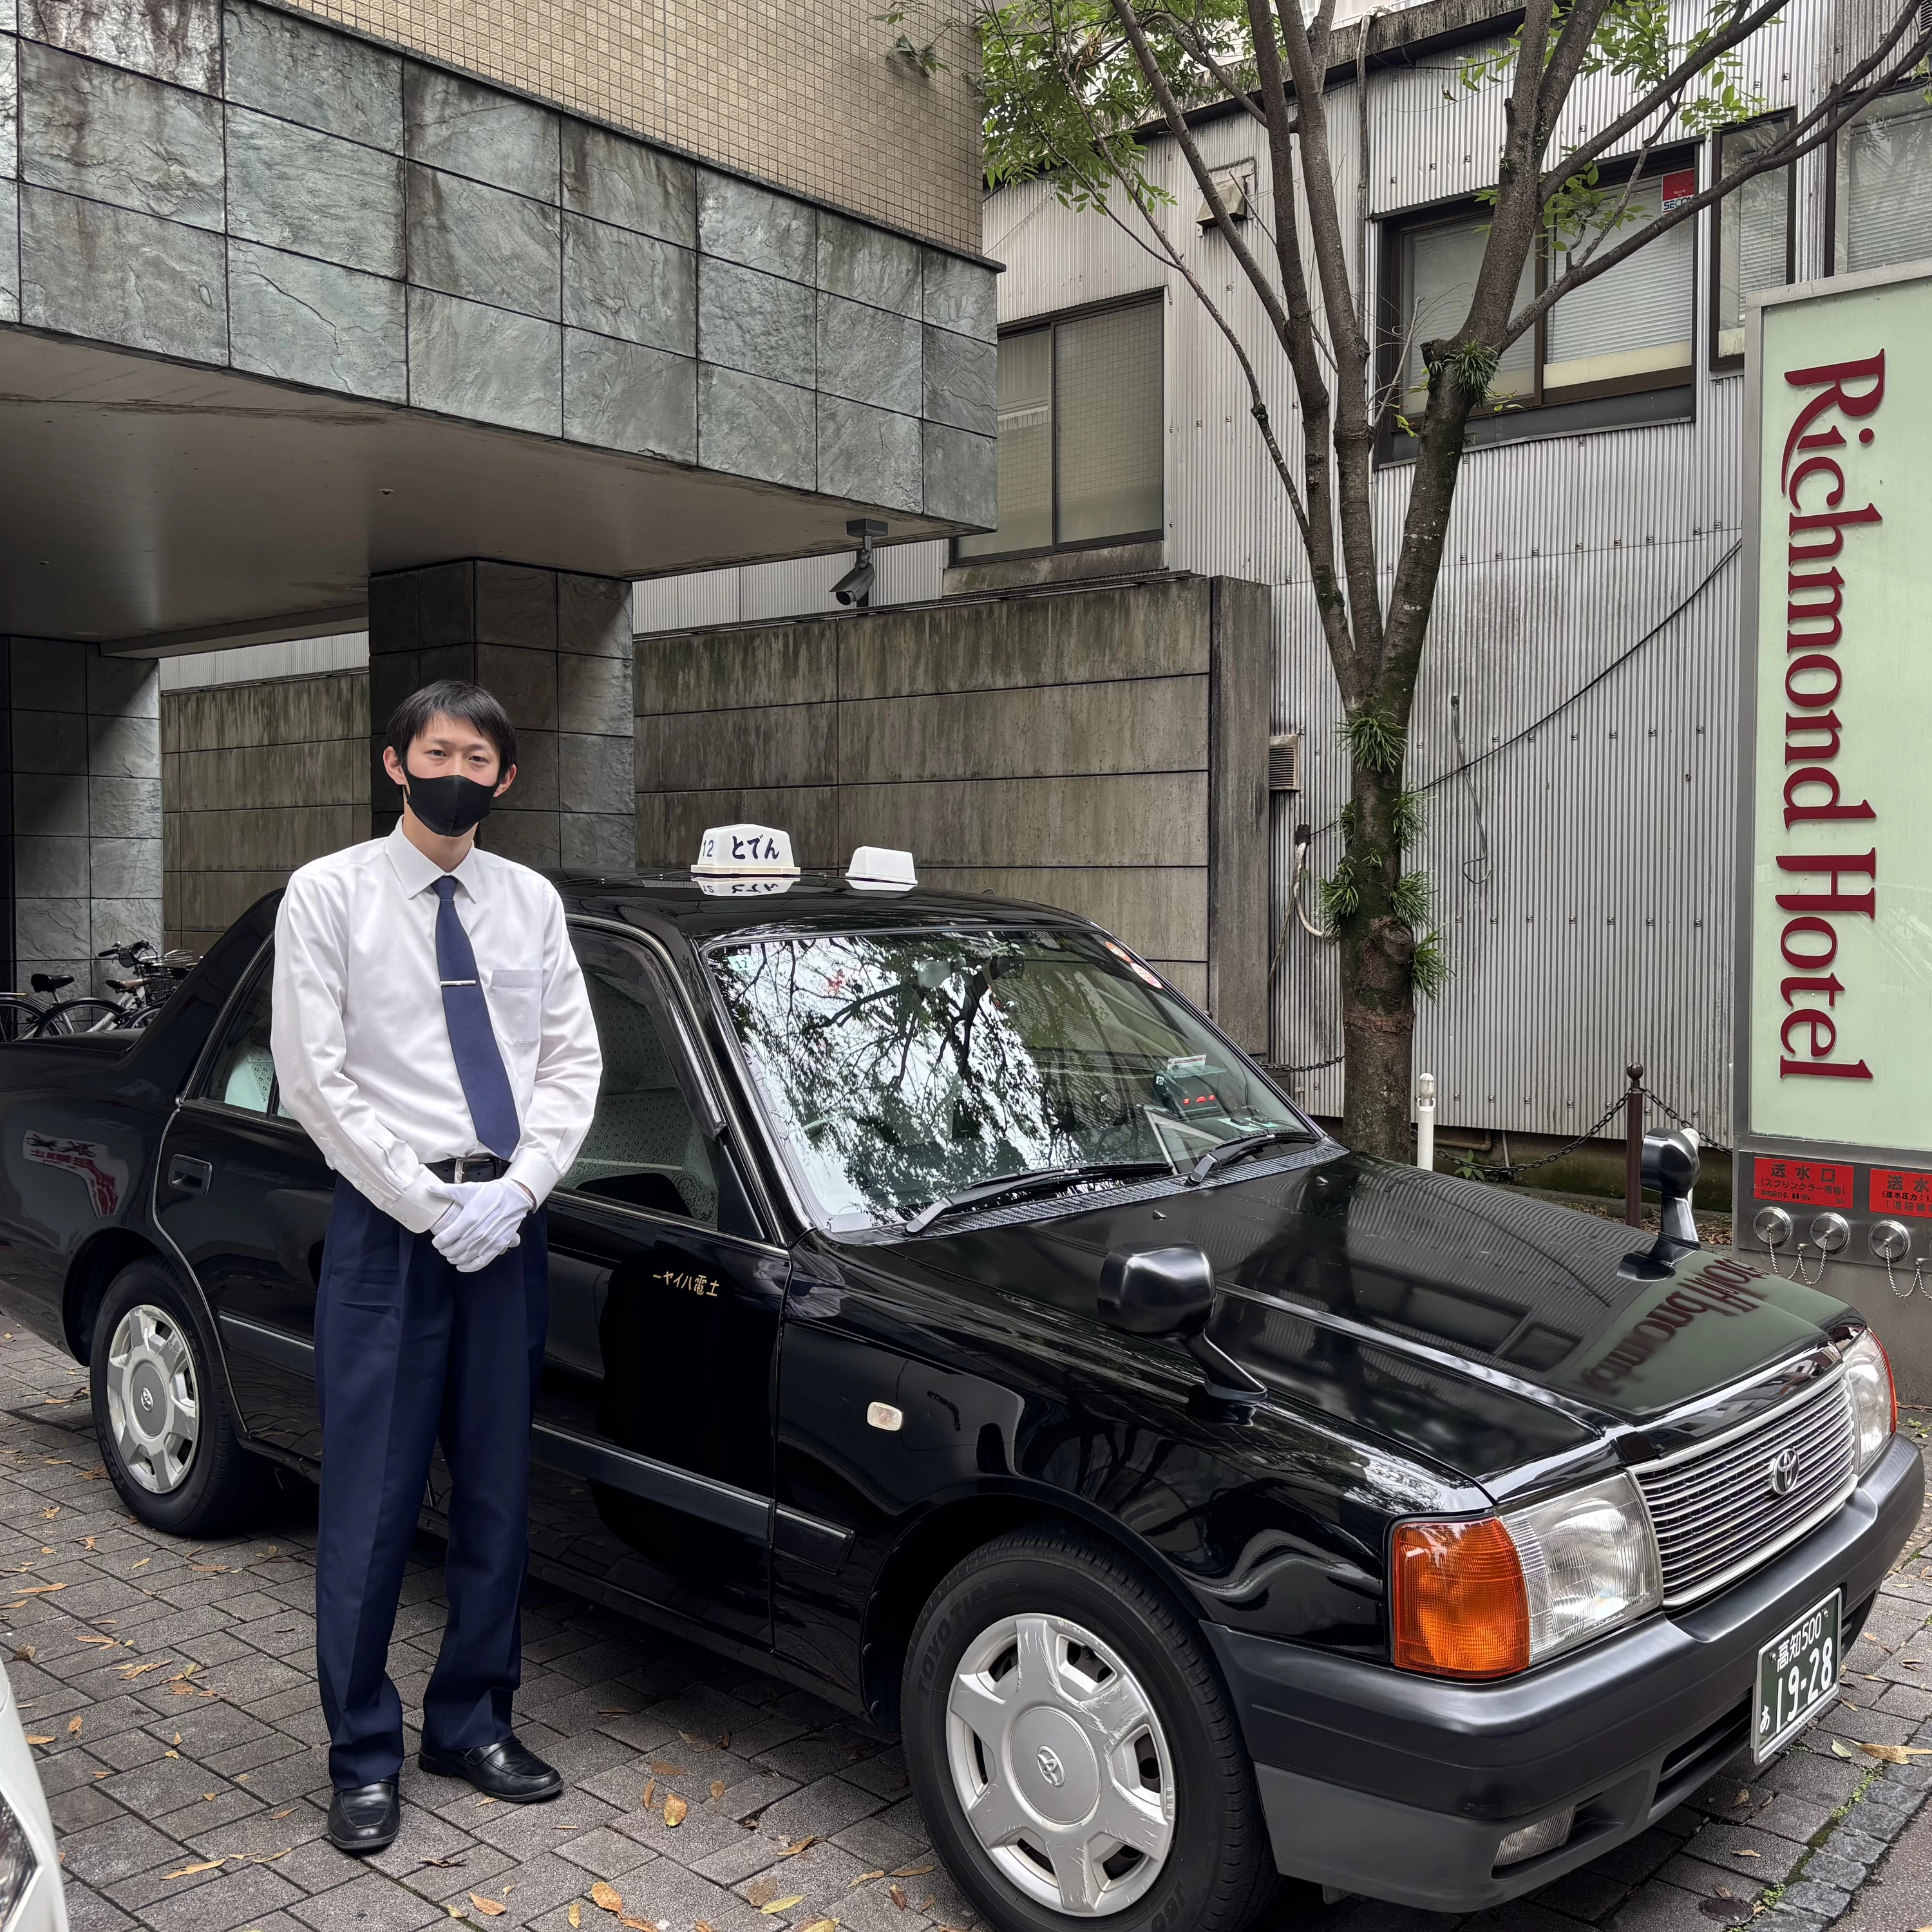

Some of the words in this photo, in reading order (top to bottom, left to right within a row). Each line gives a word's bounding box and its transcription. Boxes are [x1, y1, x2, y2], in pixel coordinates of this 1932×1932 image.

[1664, 196, 1692, 210] SECO
[1781, 348, 1885, 829] Richmond
[702, 839, 714, 858] 12
[732, 835, 780, 860] とでん
[1774, 847, 1877, 1079] Hotel
[1771, 1162, 1836, 1183] 送水口
[1759, 1705, 1771, 1734] あ
[1776, 1636, 1833, 1734] 19-28
